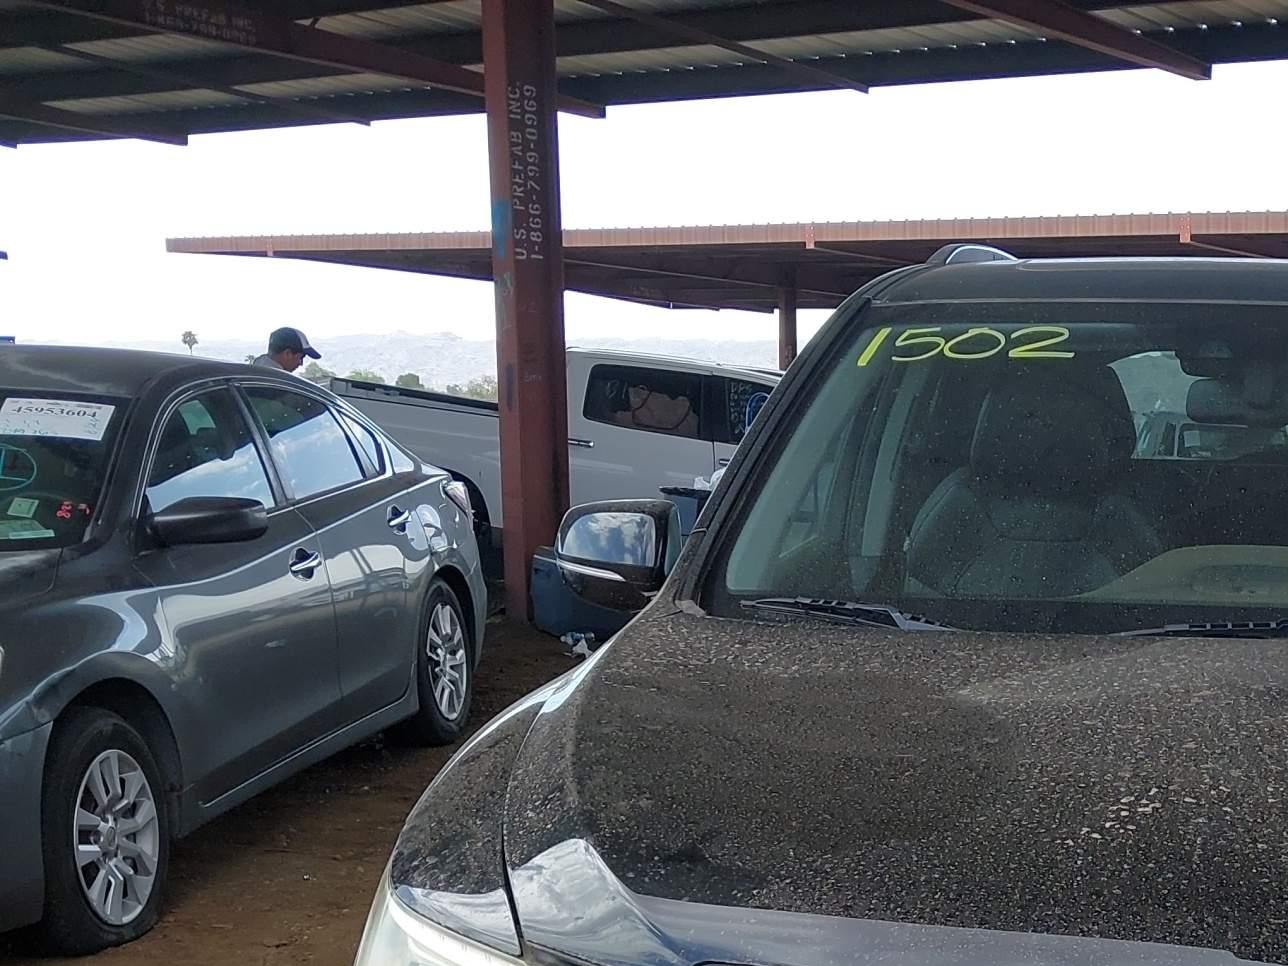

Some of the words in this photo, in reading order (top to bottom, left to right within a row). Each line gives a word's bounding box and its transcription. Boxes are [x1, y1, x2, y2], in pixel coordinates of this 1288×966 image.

[508, 82, 521, 119] INC.
[509, 131, 525, 210] PREFAB
[523, 85, 544, 260] 1-866-799-0969
[514, 222, 529, 260] U.S.
[857, 326, 1076, 367] 1502
[11, 405, 97, 418] 45953604
